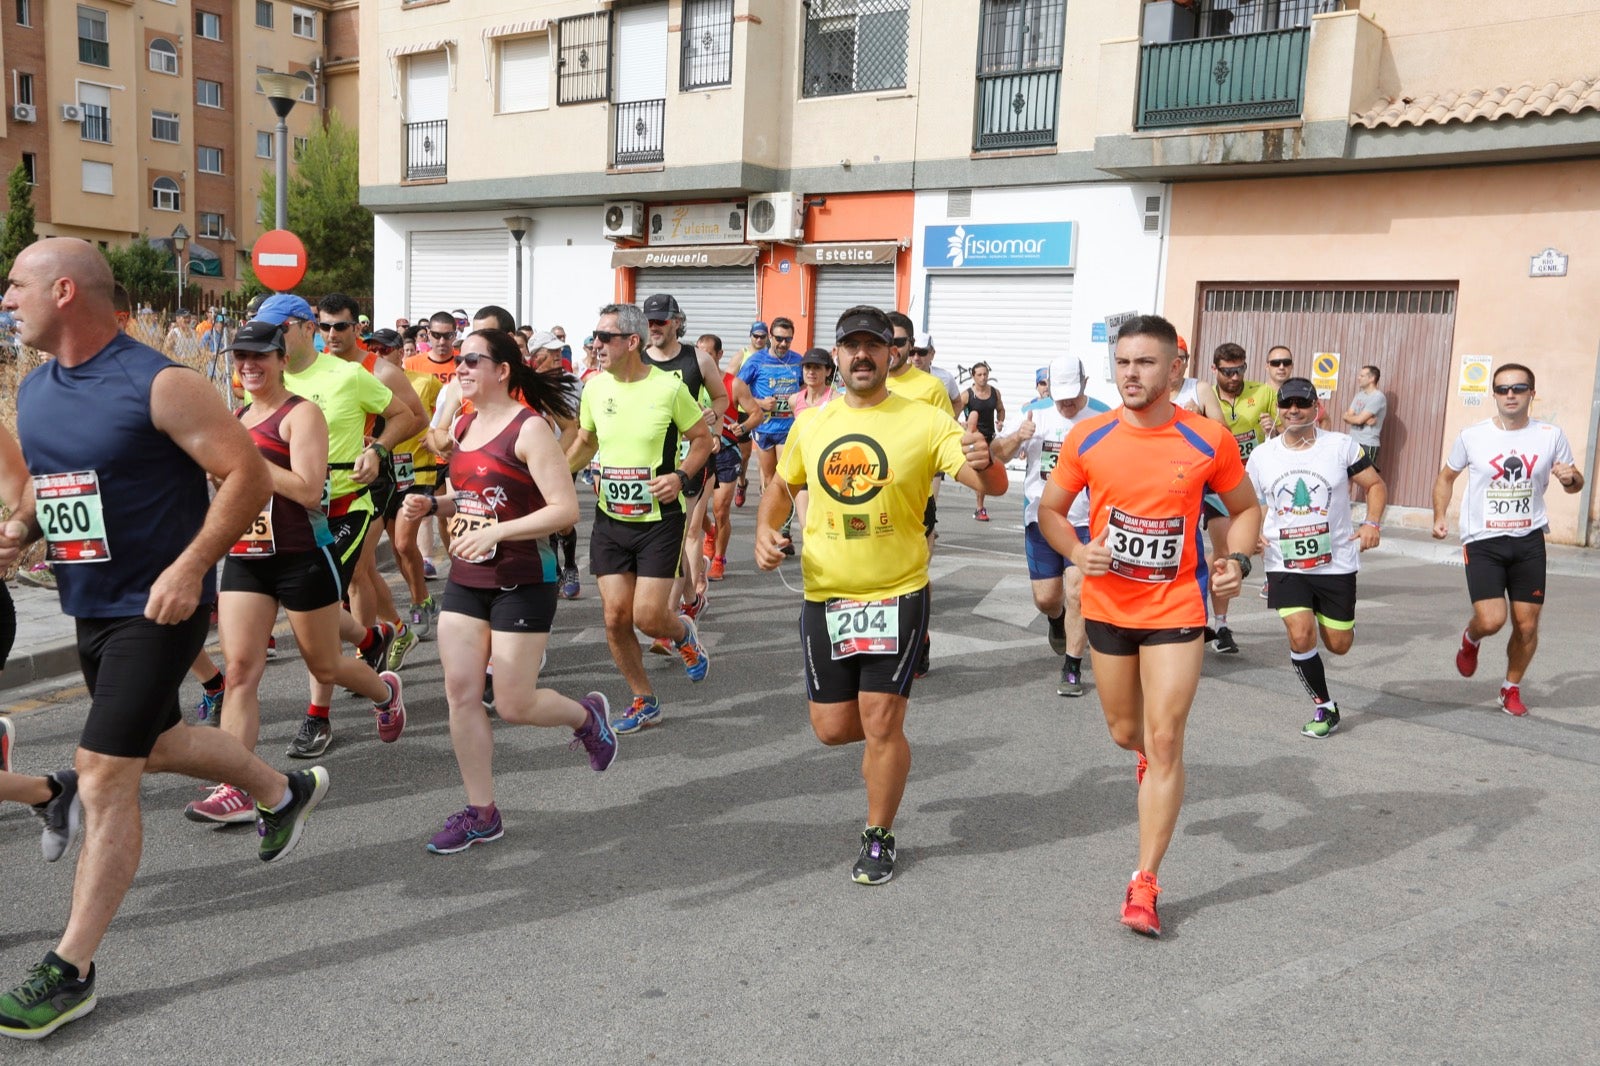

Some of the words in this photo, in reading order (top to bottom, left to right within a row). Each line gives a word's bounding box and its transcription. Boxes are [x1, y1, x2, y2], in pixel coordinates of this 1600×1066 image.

[645, 252, 709, 265] Peluqueria
[815, 248, 873, 261] Estetica
[829, 451, 842, 463] EL
[826, 463, 879, 476] MAMUT
[608, 482, 644, 500] 992
[1487, 497, 1530, 515] 3078
[43, 501, 90, 534] 260
[1113, 532, 1179, 560] 3015
[1295, 538, 1319, 556] 59
[837, 610, 887, 636] 204
